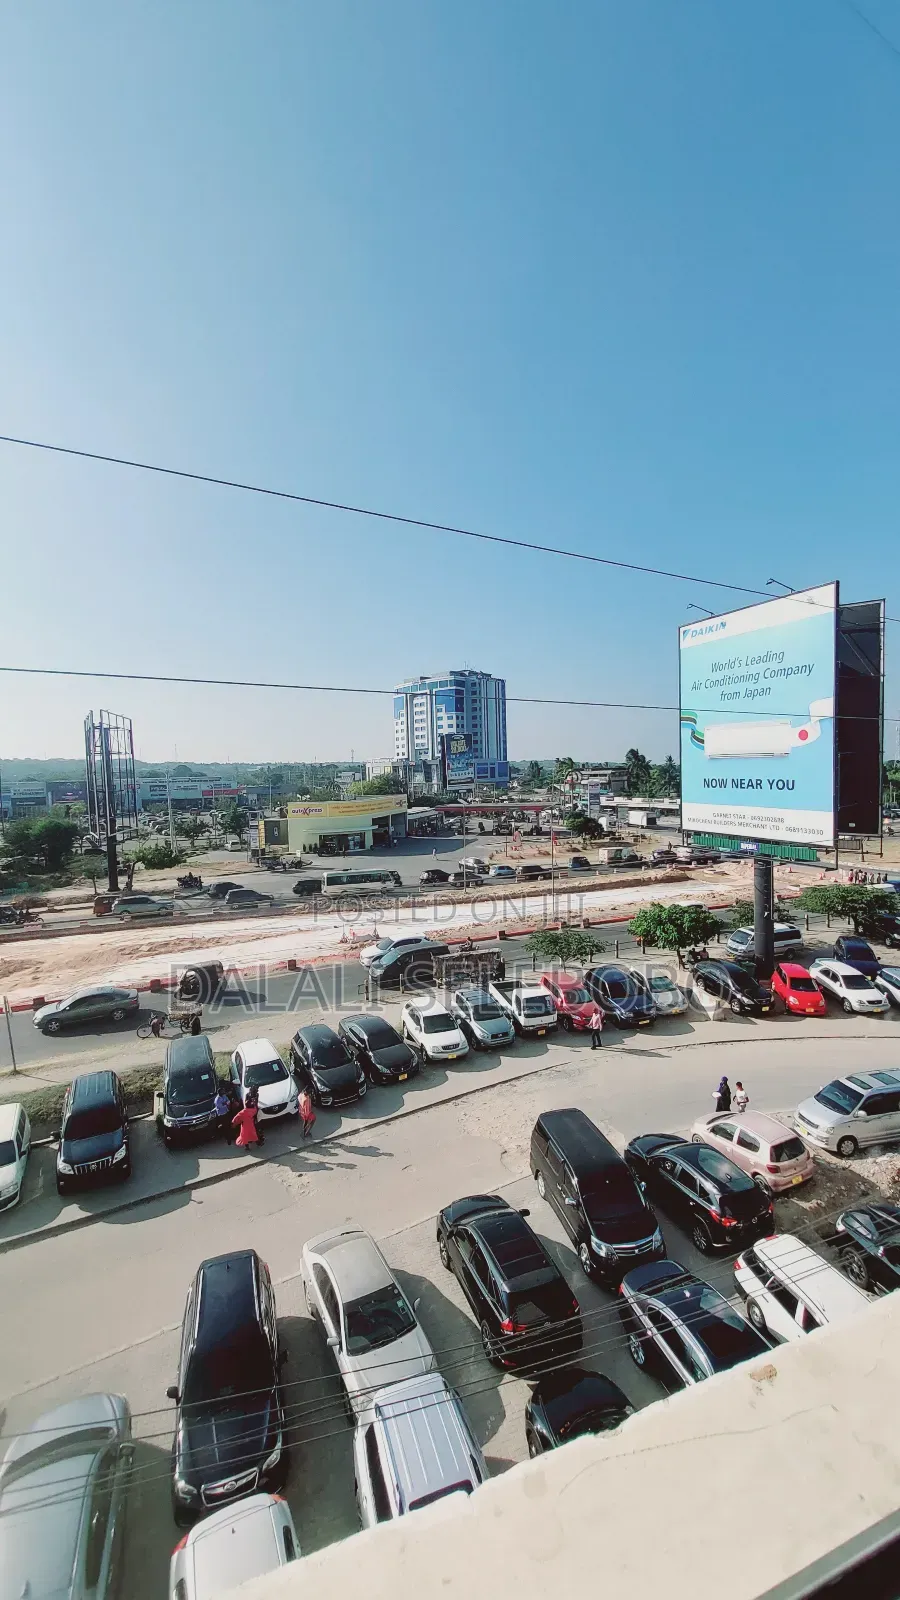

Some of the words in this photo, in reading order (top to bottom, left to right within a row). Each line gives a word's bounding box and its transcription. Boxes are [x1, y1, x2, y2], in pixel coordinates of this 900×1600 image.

[691, 621, 727, 638] DAIKIN
[711, 656, 743, 673] World's
[745, 650, 785, 667] Leading
[691, 681, 703, 692] Air
[704, 671, 760, 690] Conditioning
[763, 663, 815, 679] Company
[720, 690, 741, 702] from
[743, 686, 771, 700] Japan
[703, 777, 728, 789] NOW
[731, 778, 763, 790] NEAR
[767, 779, 796, 791] YOU
